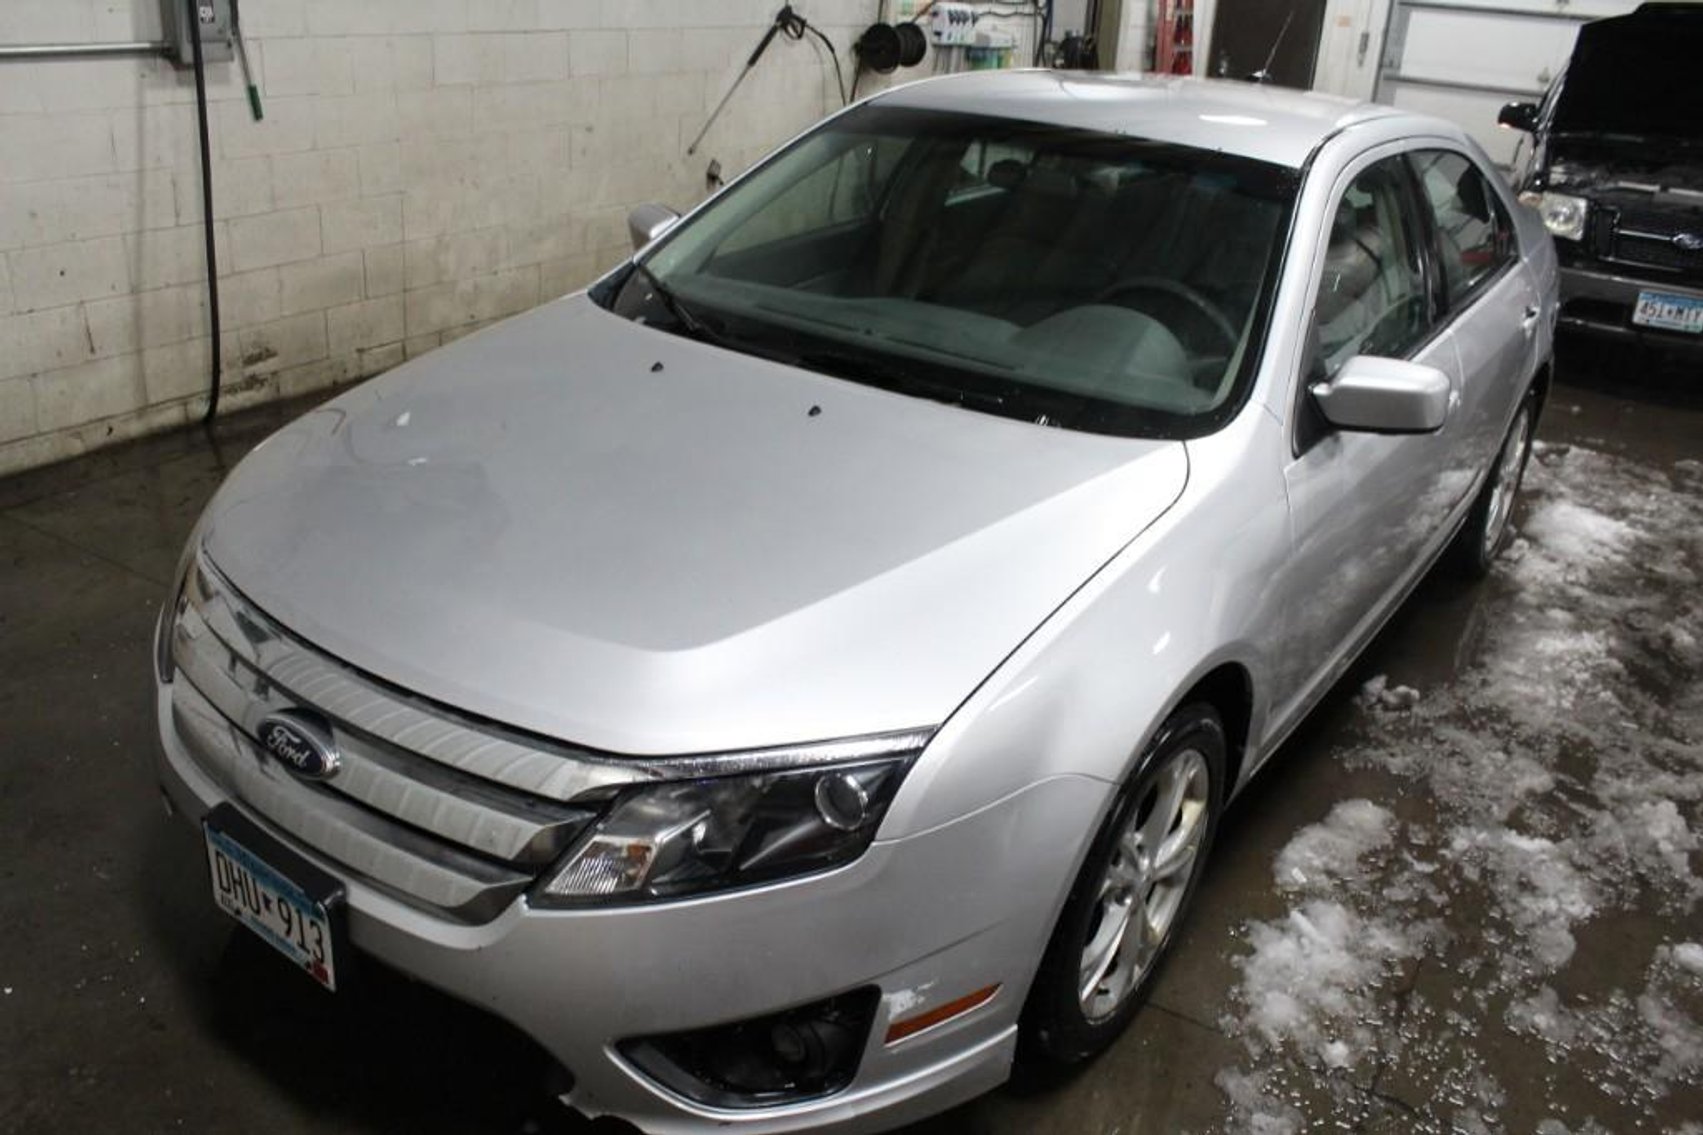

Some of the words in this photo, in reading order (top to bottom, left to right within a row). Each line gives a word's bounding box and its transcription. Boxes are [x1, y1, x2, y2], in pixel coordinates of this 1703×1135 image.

[267, 725, 311, 768] Ford
[215, 849, 261, 915] DHU
[277, 896, 325, 964] 913
